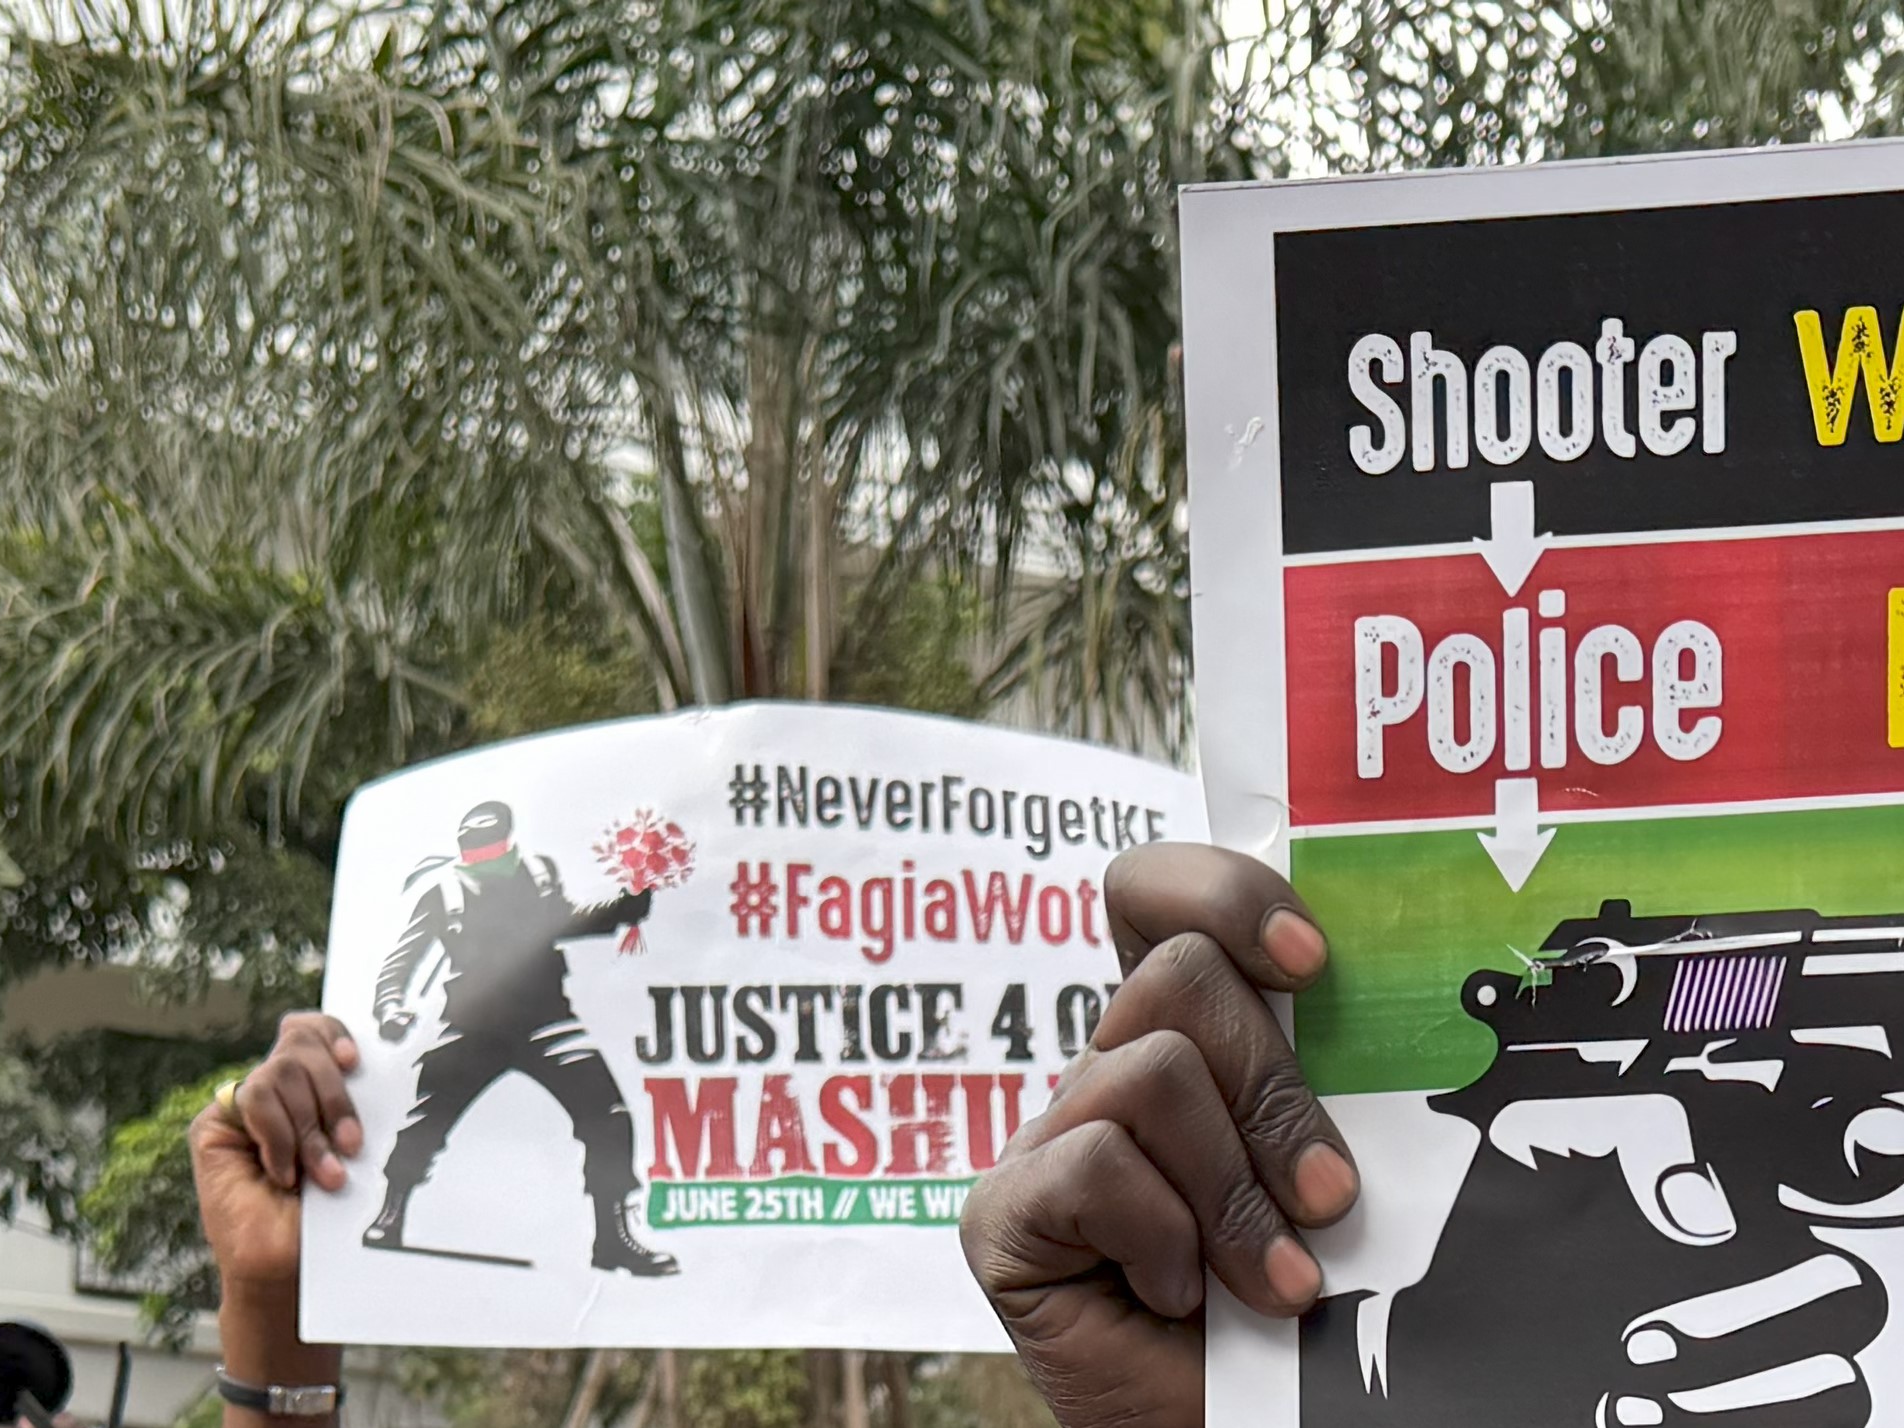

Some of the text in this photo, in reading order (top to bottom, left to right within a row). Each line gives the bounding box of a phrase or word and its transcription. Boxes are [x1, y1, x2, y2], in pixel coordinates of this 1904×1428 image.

[1348, 317, 1737, 475] Shooter
[1355, 587, 1723, 780] Police
[730, 861, 1111, 964] #FagiaWot
[634, 982, 967, 1063] JUSTICE
[991, 982, 1034, 1061] 4
[644, 1073, 1060, 1179] MASHU
[661, 1184, 970, 1222] JUNE 25TH // WE WI
